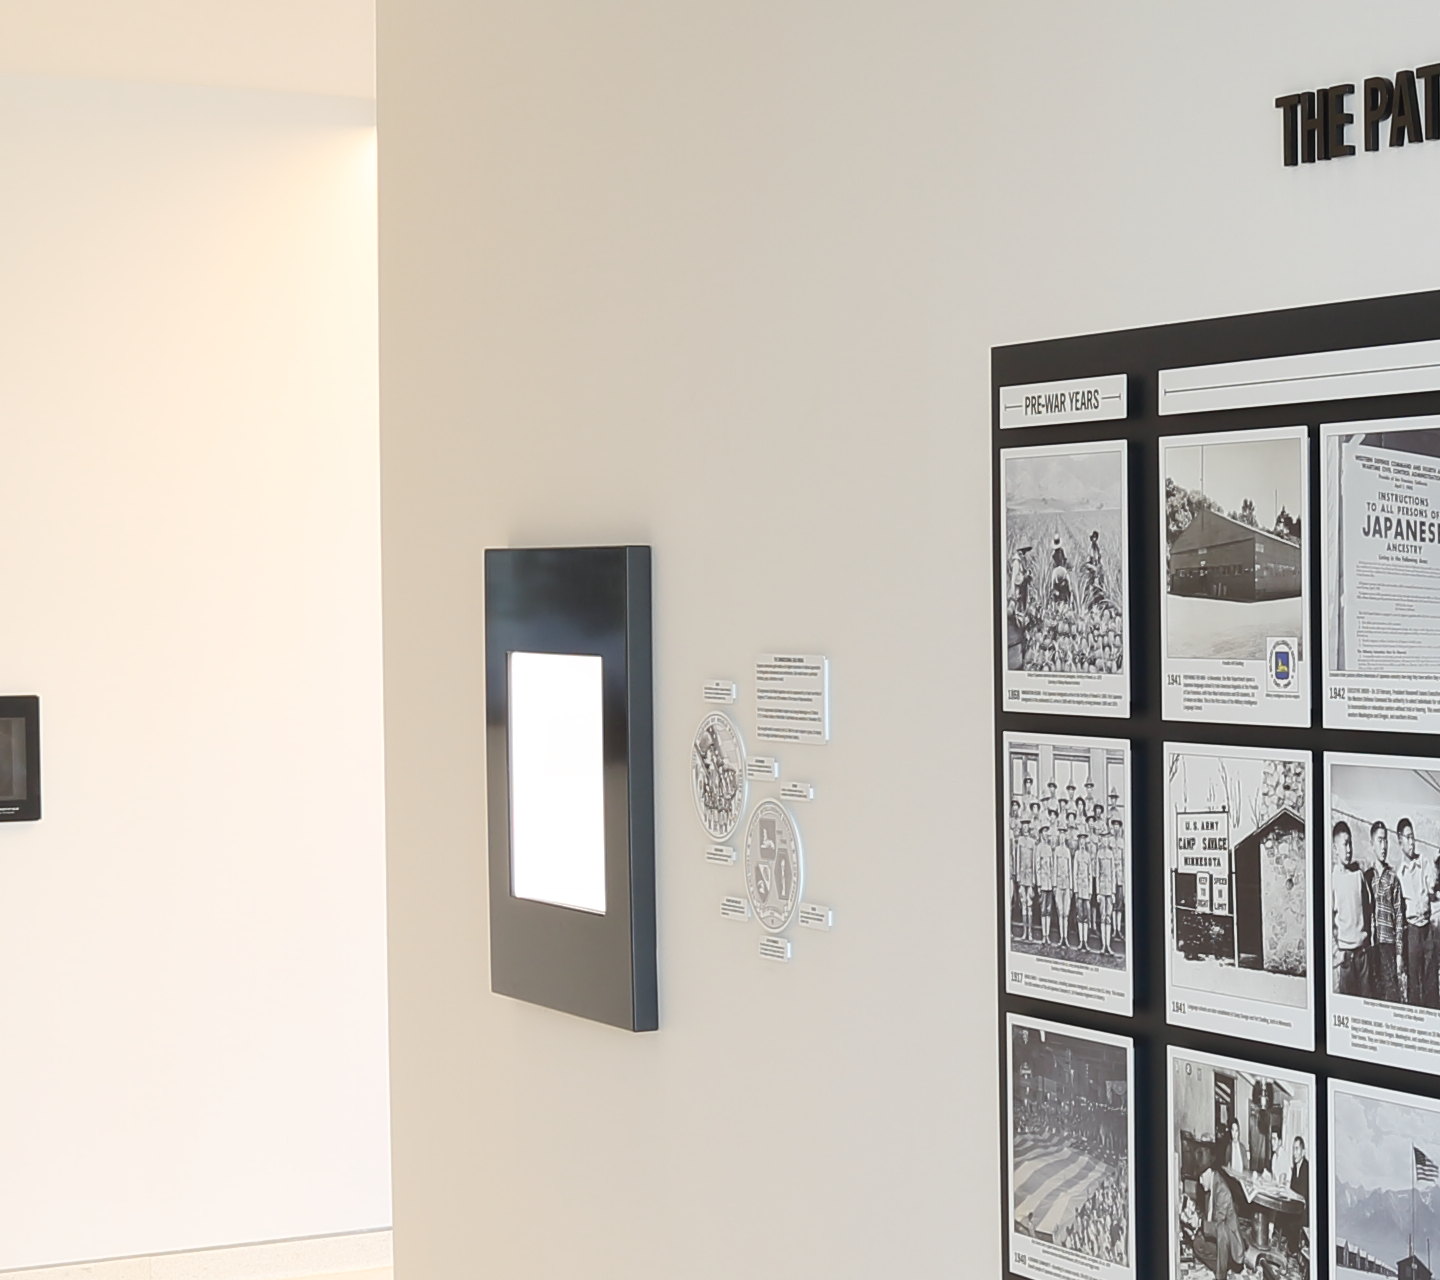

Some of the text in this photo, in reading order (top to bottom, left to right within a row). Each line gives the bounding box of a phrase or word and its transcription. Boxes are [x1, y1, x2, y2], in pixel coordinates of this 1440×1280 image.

[1275, 84, 1356, 167] THE
[1024, 389, 1100, 416] PRE-WAR YEARS
[1378, 491, 1429, 507] INSTRUCTIONS
[1366, 502, 1440, 520] TO ALL PERSONS OF
[1386, 542, 1423, 555] ANCESTRY
[1178, 837, 1227, 850] CAMP SAVAGE
